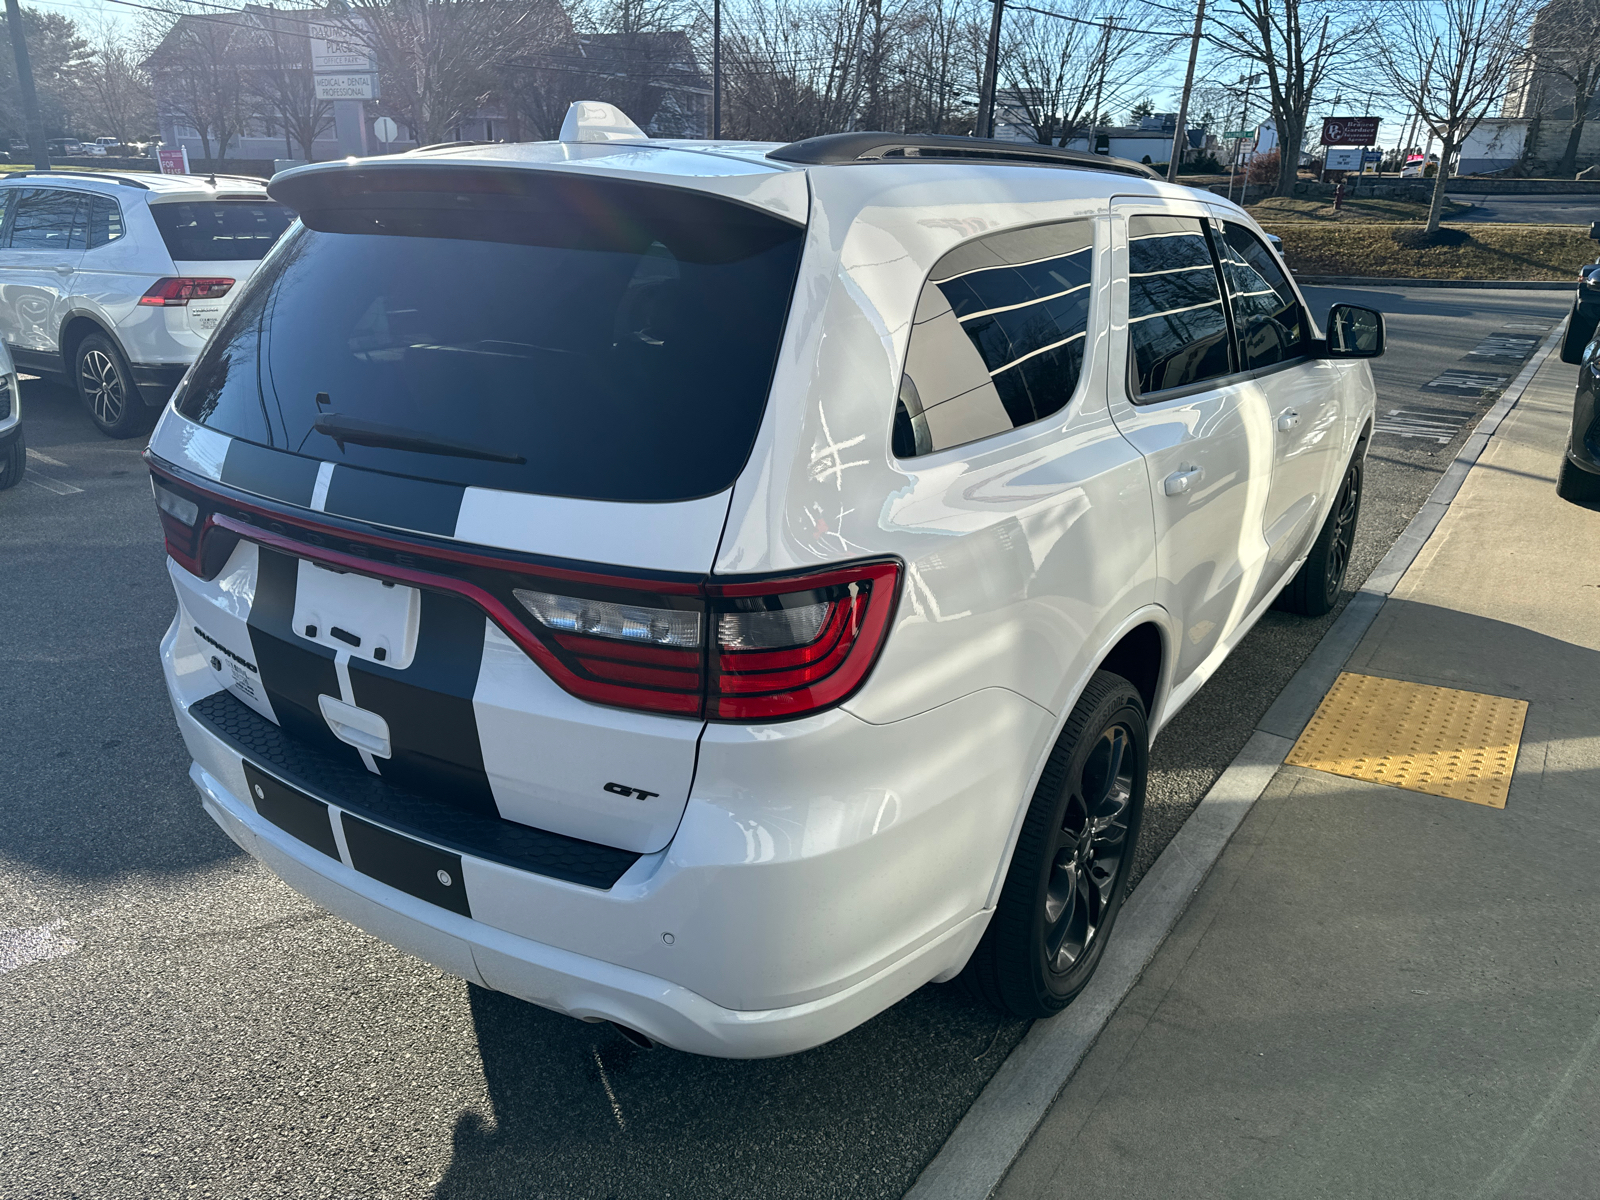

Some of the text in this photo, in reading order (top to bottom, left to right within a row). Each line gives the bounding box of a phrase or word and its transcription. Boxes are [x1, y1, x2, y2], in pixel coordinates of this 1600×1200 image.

[316, 77, 370, 87] MEDICAL DENTAL
[322, 87, 365, 96] PROFESSIONAL
[162, 160, 174, 168] FOR
[237, 511, 415, 567] DODGE
[603, 781, 660, 801] GT
